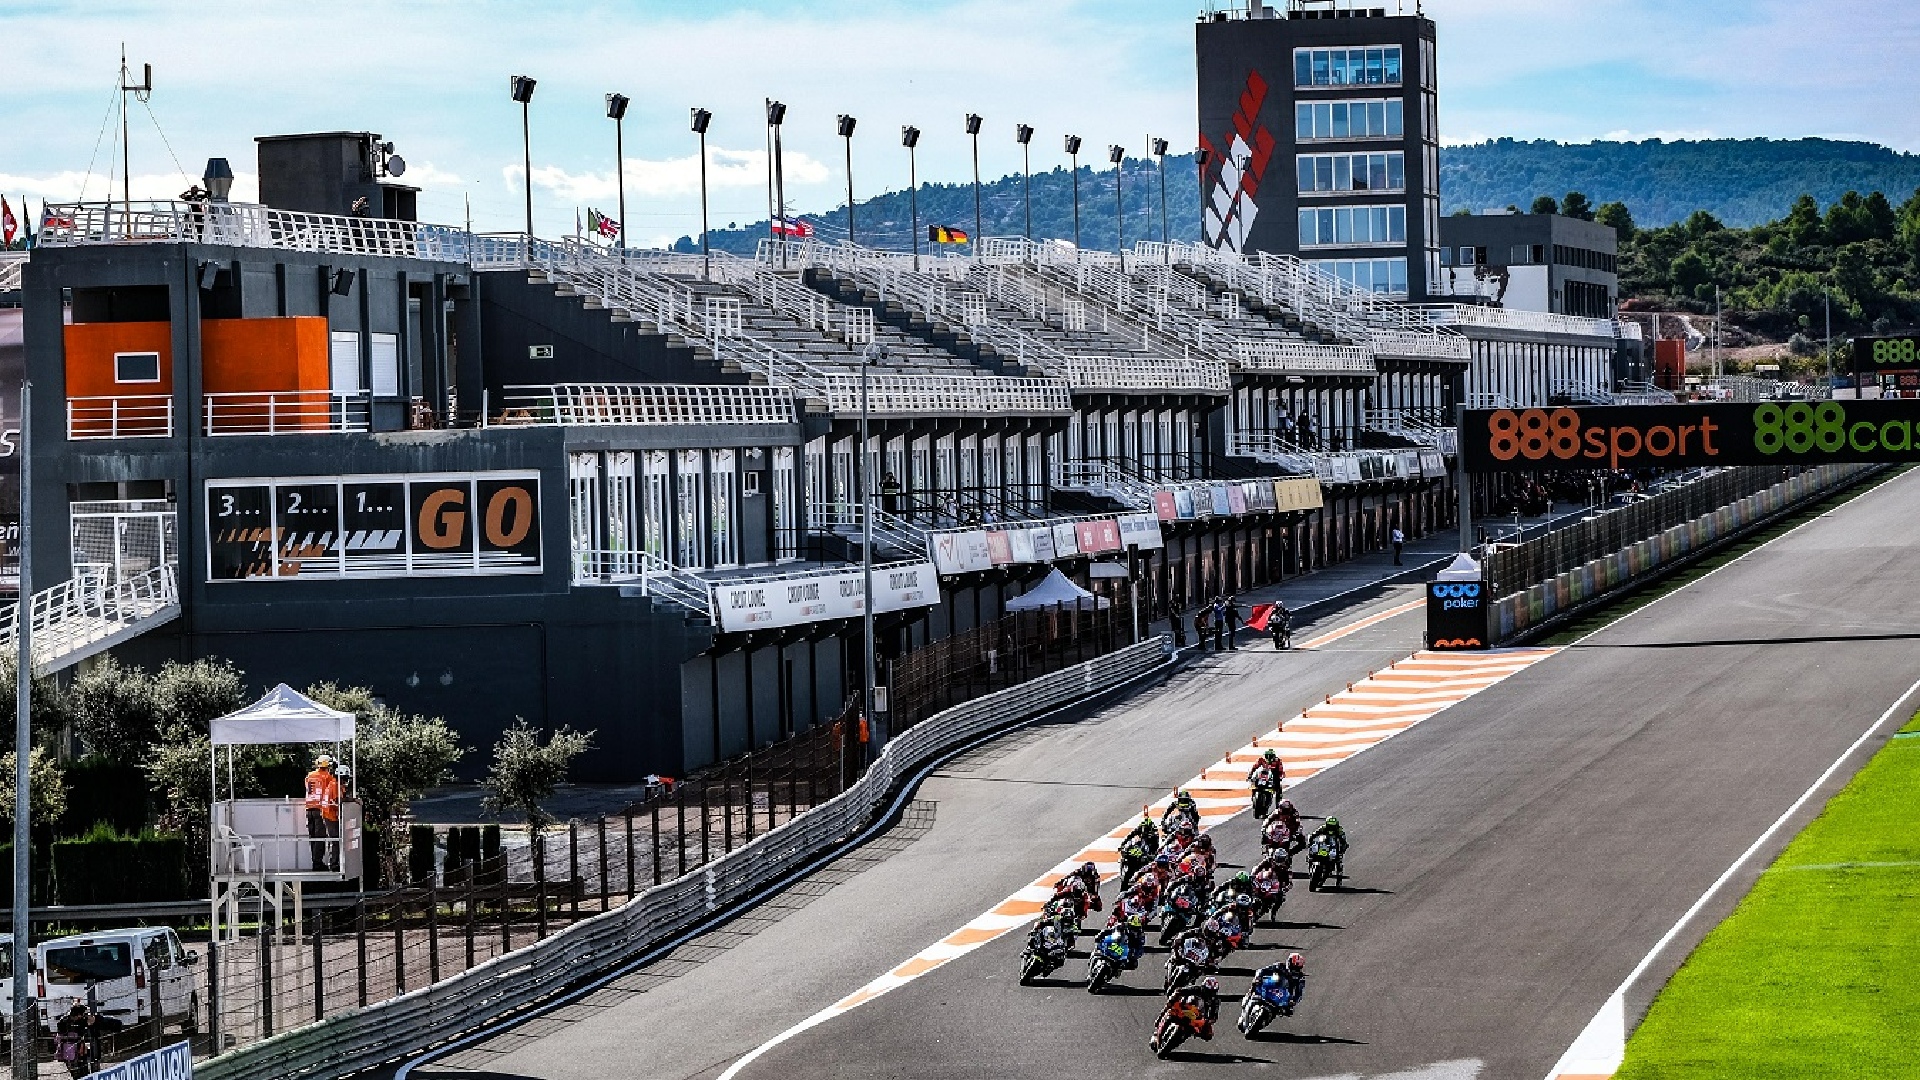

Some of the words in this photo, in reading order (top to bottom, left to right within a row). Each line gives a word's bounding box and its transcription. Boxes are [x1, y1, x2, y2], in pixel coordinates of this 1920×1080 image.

[1488, 407, 1719, 469] 888sport
[418, 486, 532, 549] GO
[1443, 597, 1479, 611] poker
